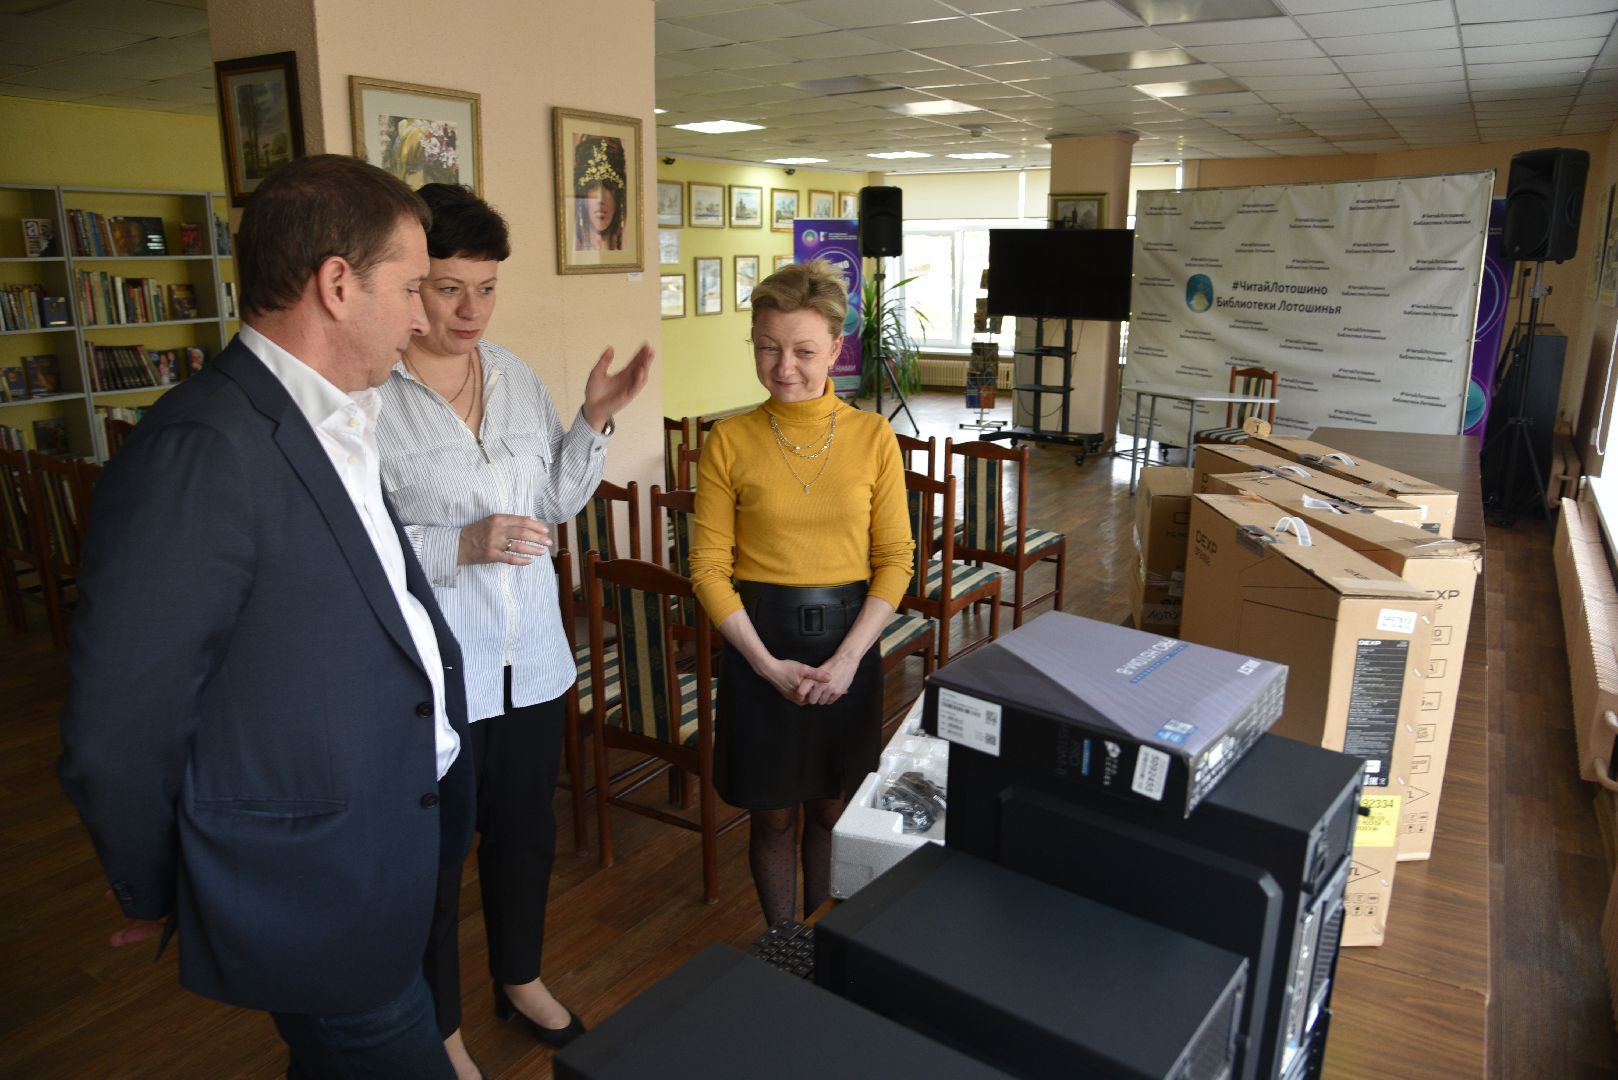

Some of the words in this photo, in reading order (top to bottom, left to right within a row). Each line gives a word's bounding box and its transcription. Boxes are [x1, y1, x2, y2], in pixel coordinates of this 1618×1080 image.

[1231, 280, 1328, 295] #ЧитайЛотошино
[1216, 296, 1276, 311] Библиотеки
[1277, 300, 1342, 315] Лотошинья
[1361, 798, 1394, 809] 92334
